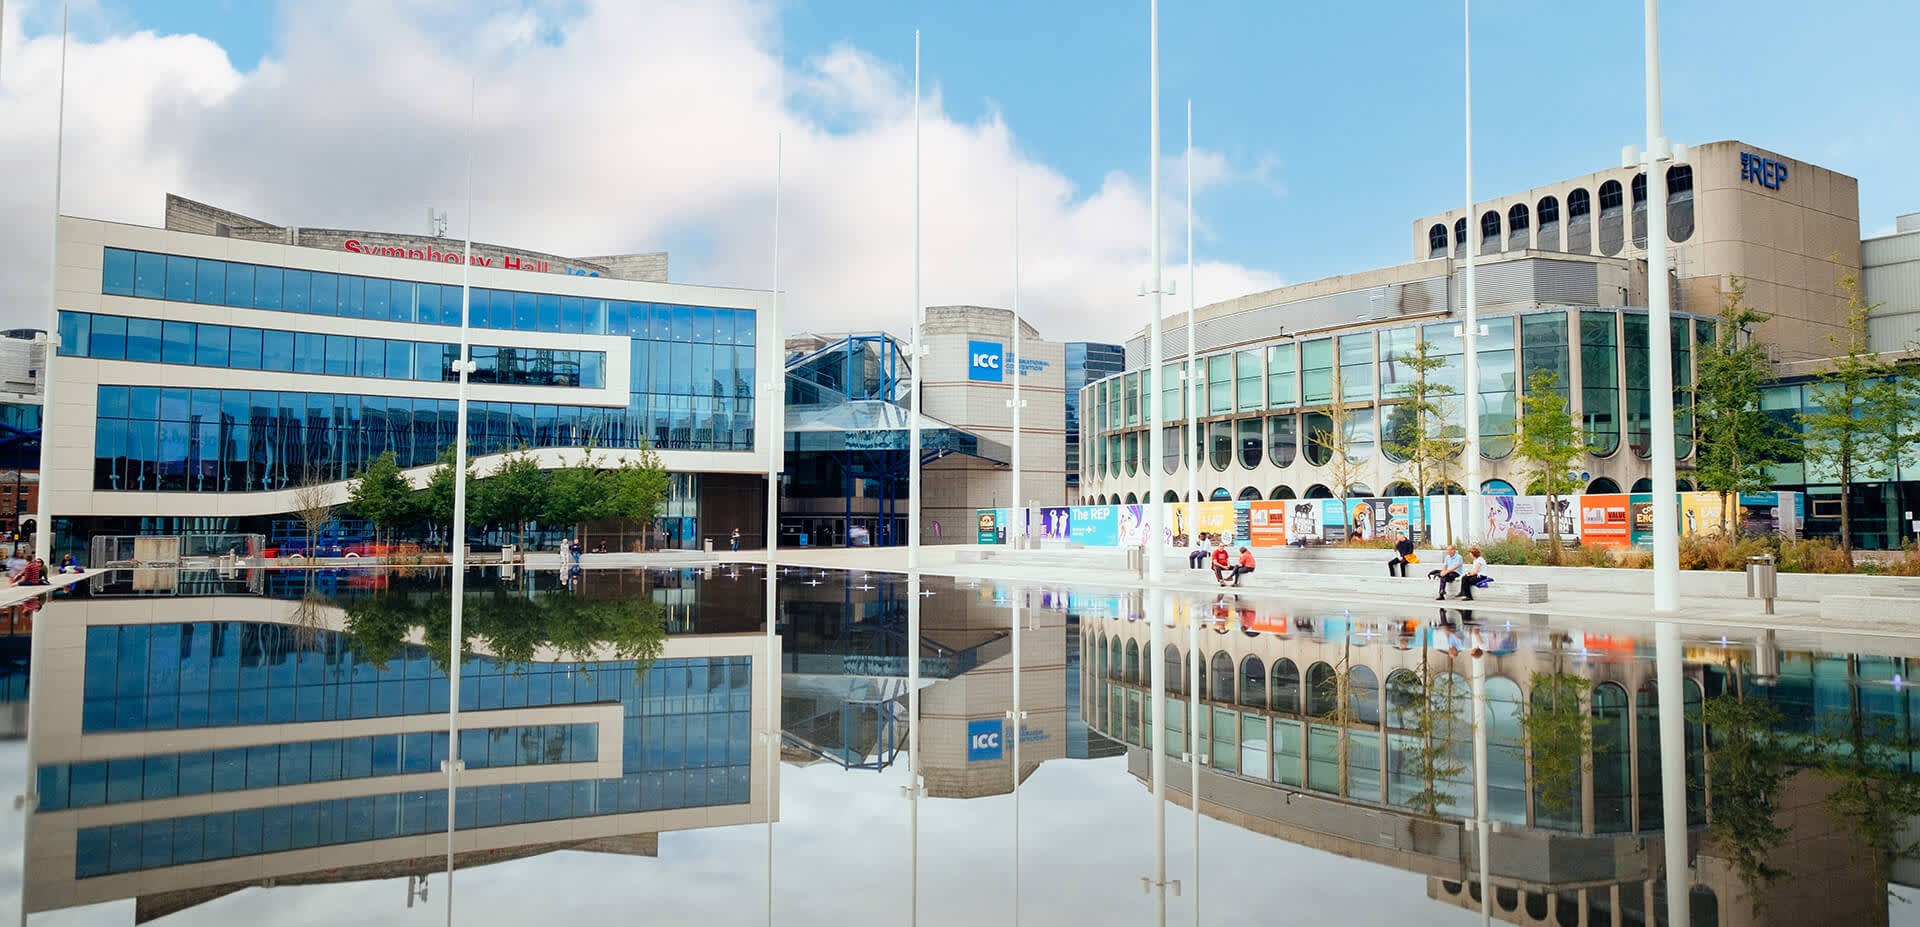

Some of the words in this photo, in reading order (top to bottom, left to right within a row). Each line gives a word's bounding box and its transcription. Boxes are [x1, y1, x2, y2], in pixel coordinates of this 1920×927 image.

[1740, 151, 1749, 180] THE
[1749, 154, 1788, 190] REP
[973, 353, 999, 368] ICC
[1072, 508, 1089, 522] The
[1091, 508, 1110, 522] REP
